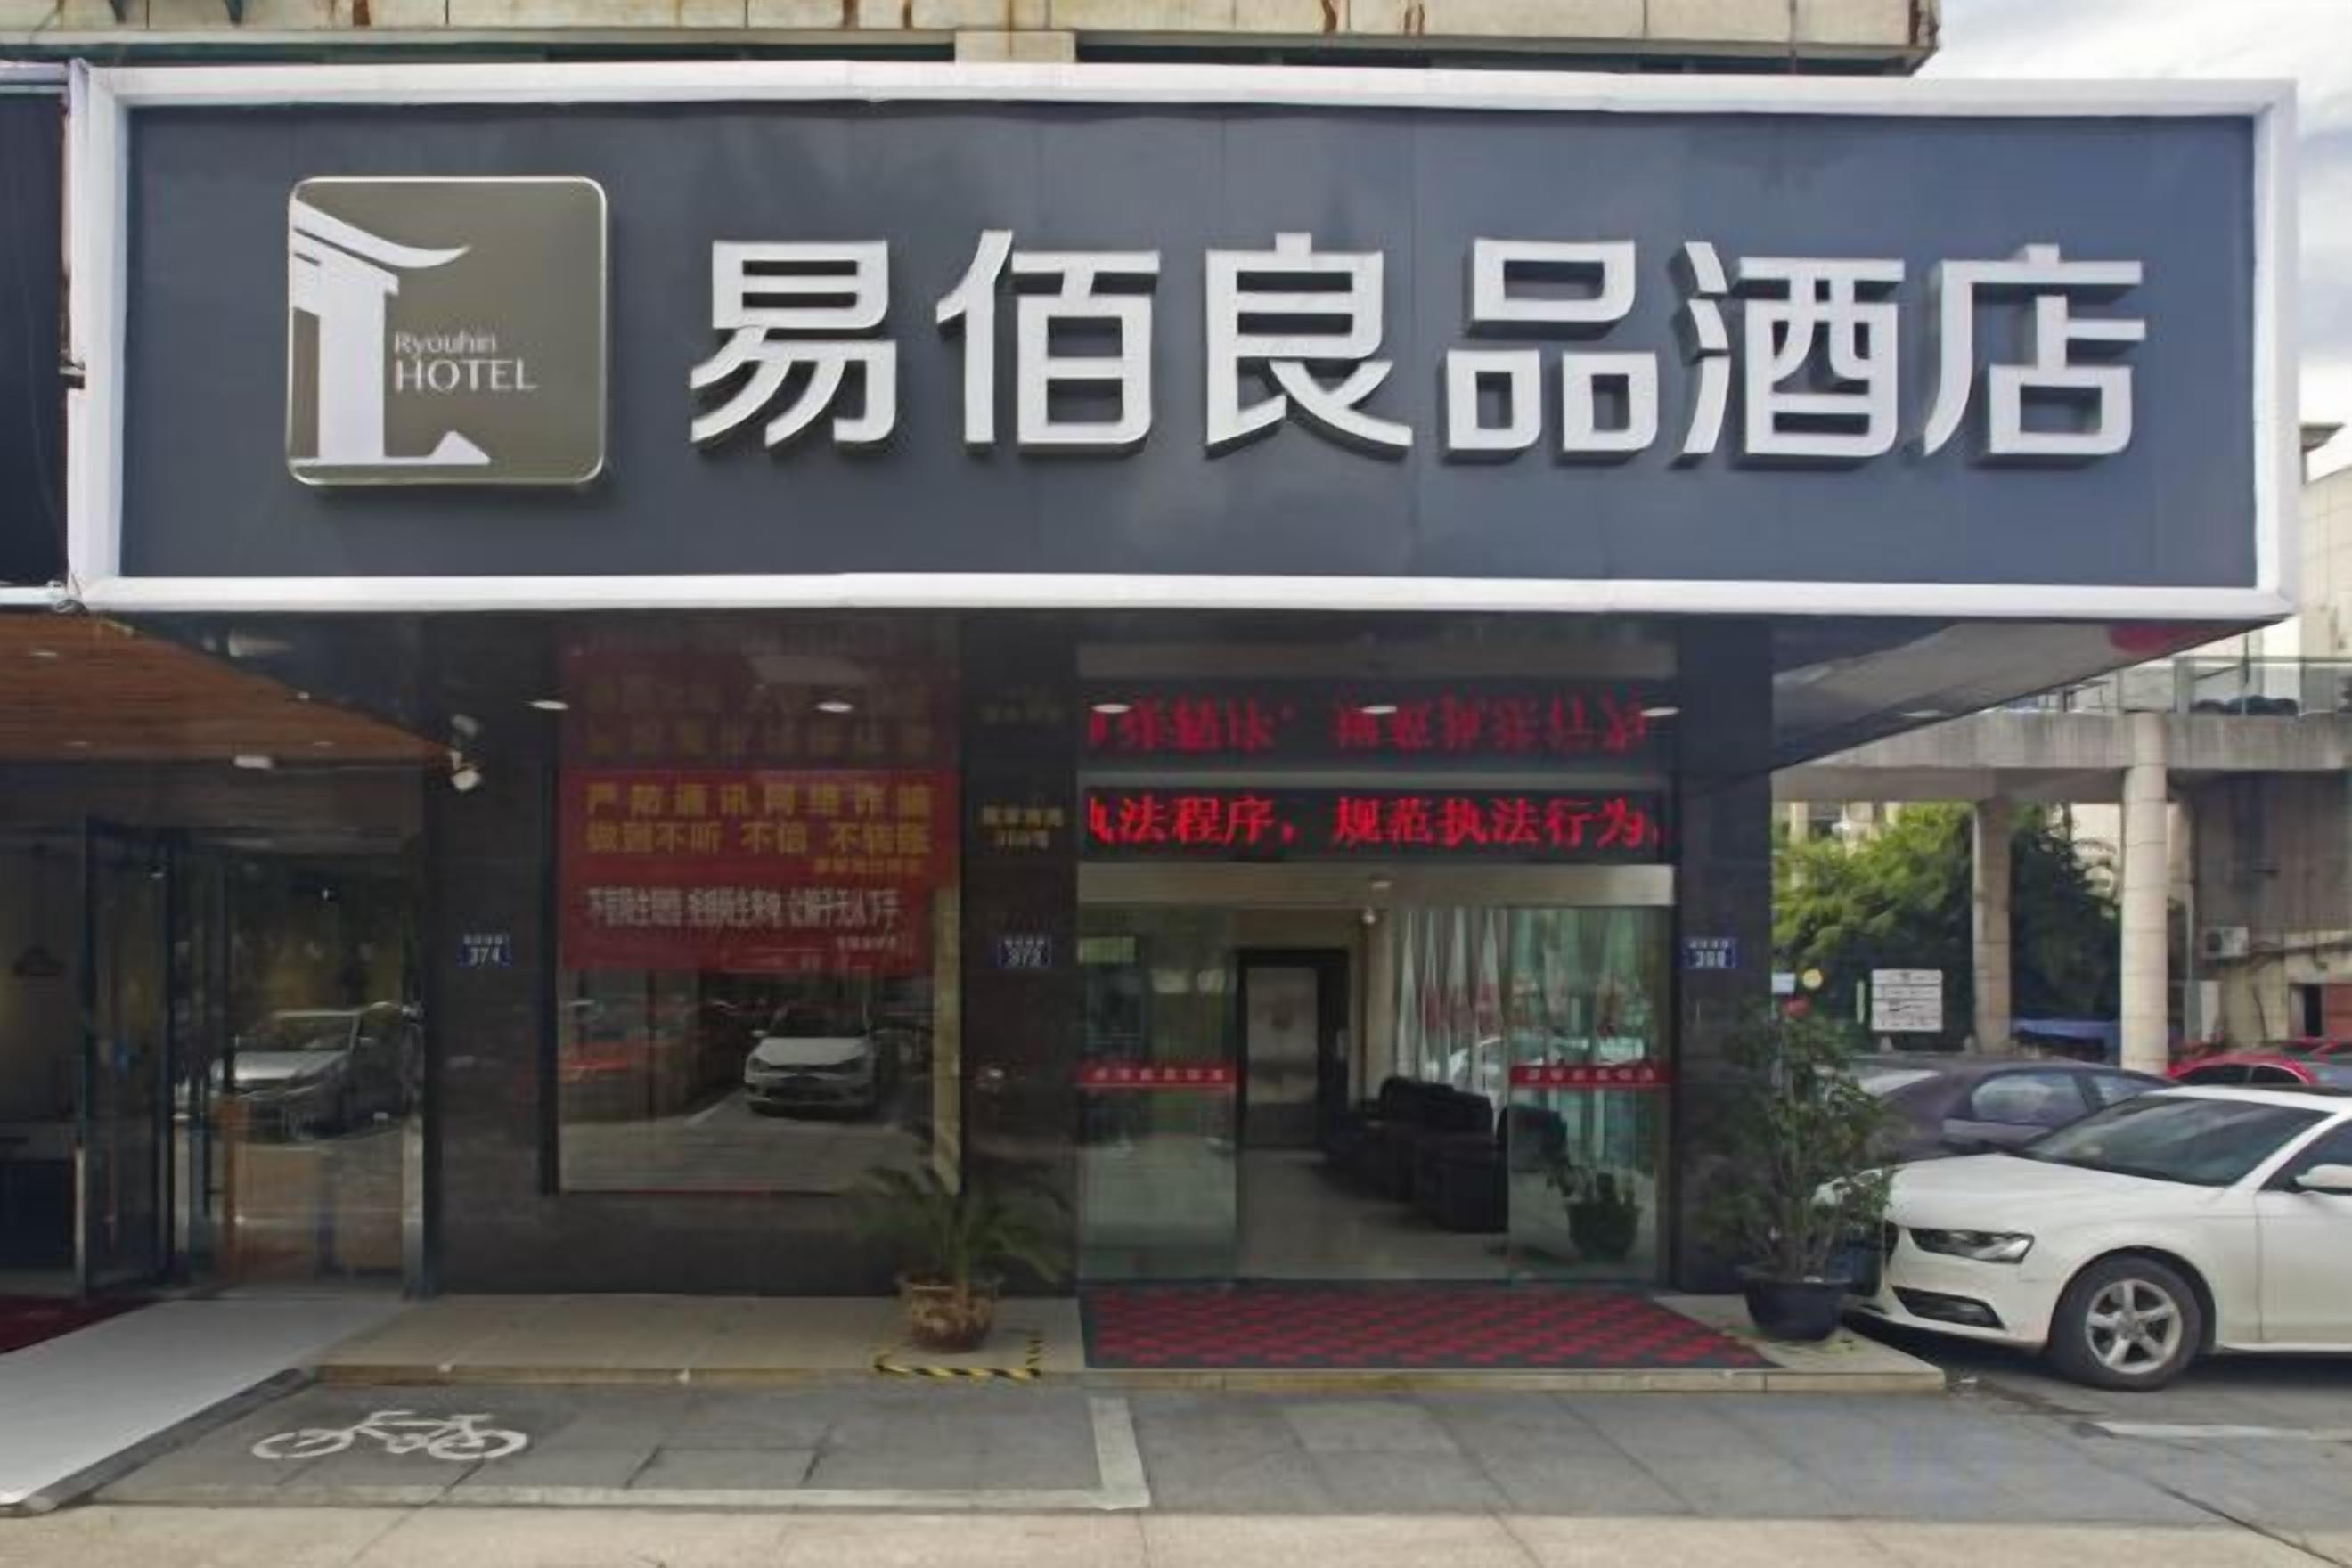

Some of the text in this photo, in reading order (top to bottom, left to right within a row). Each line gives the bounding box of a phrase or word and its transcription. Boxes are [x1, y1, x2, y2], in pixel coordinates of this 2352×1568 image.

[395, 358, 538, 392] HOTEL
[691, 229, 2145, 457] 易佰良品酒店
